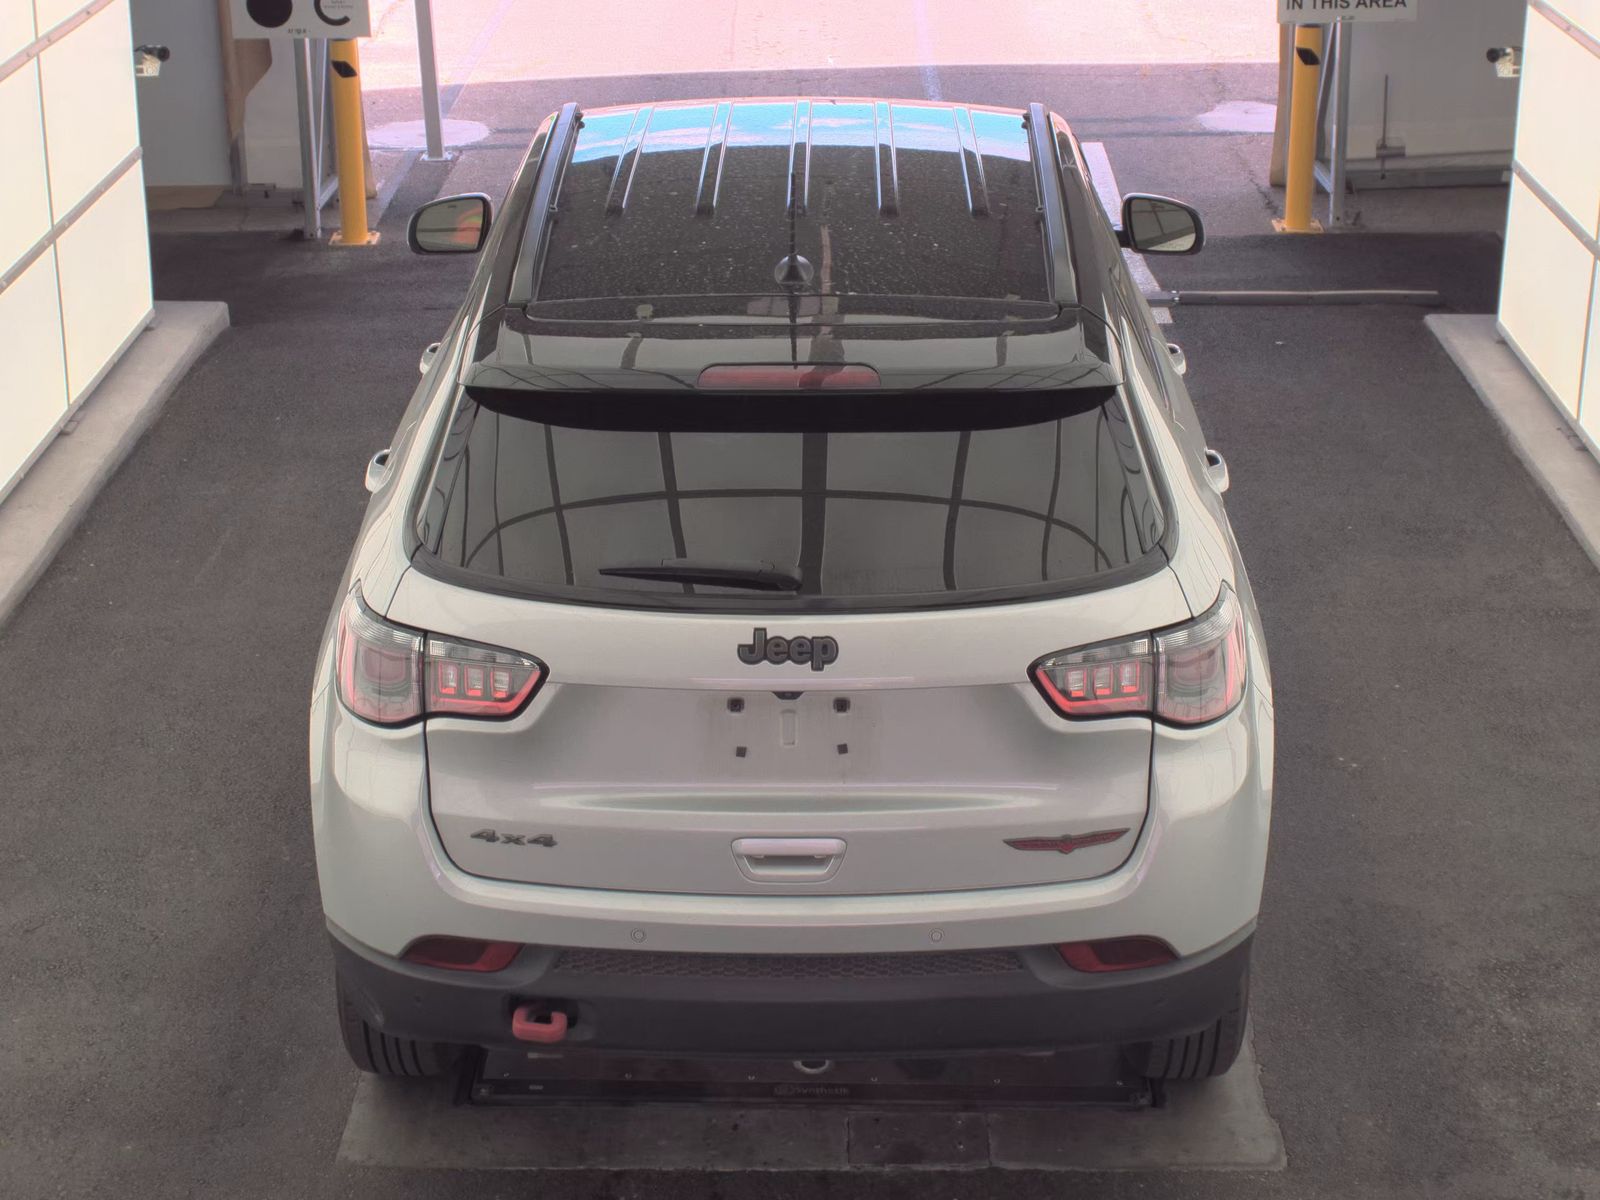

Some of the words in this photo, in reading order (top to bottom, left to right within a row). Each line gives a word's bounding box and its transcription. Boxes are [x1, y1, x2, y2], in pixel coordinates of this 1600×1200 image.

[1286, 0, 1303, 10] IN
[1312, 0, 1350, 9] THIS
[1355, 0, 1407, 9] AREA
[737, 627, 839, 672] Jeep
